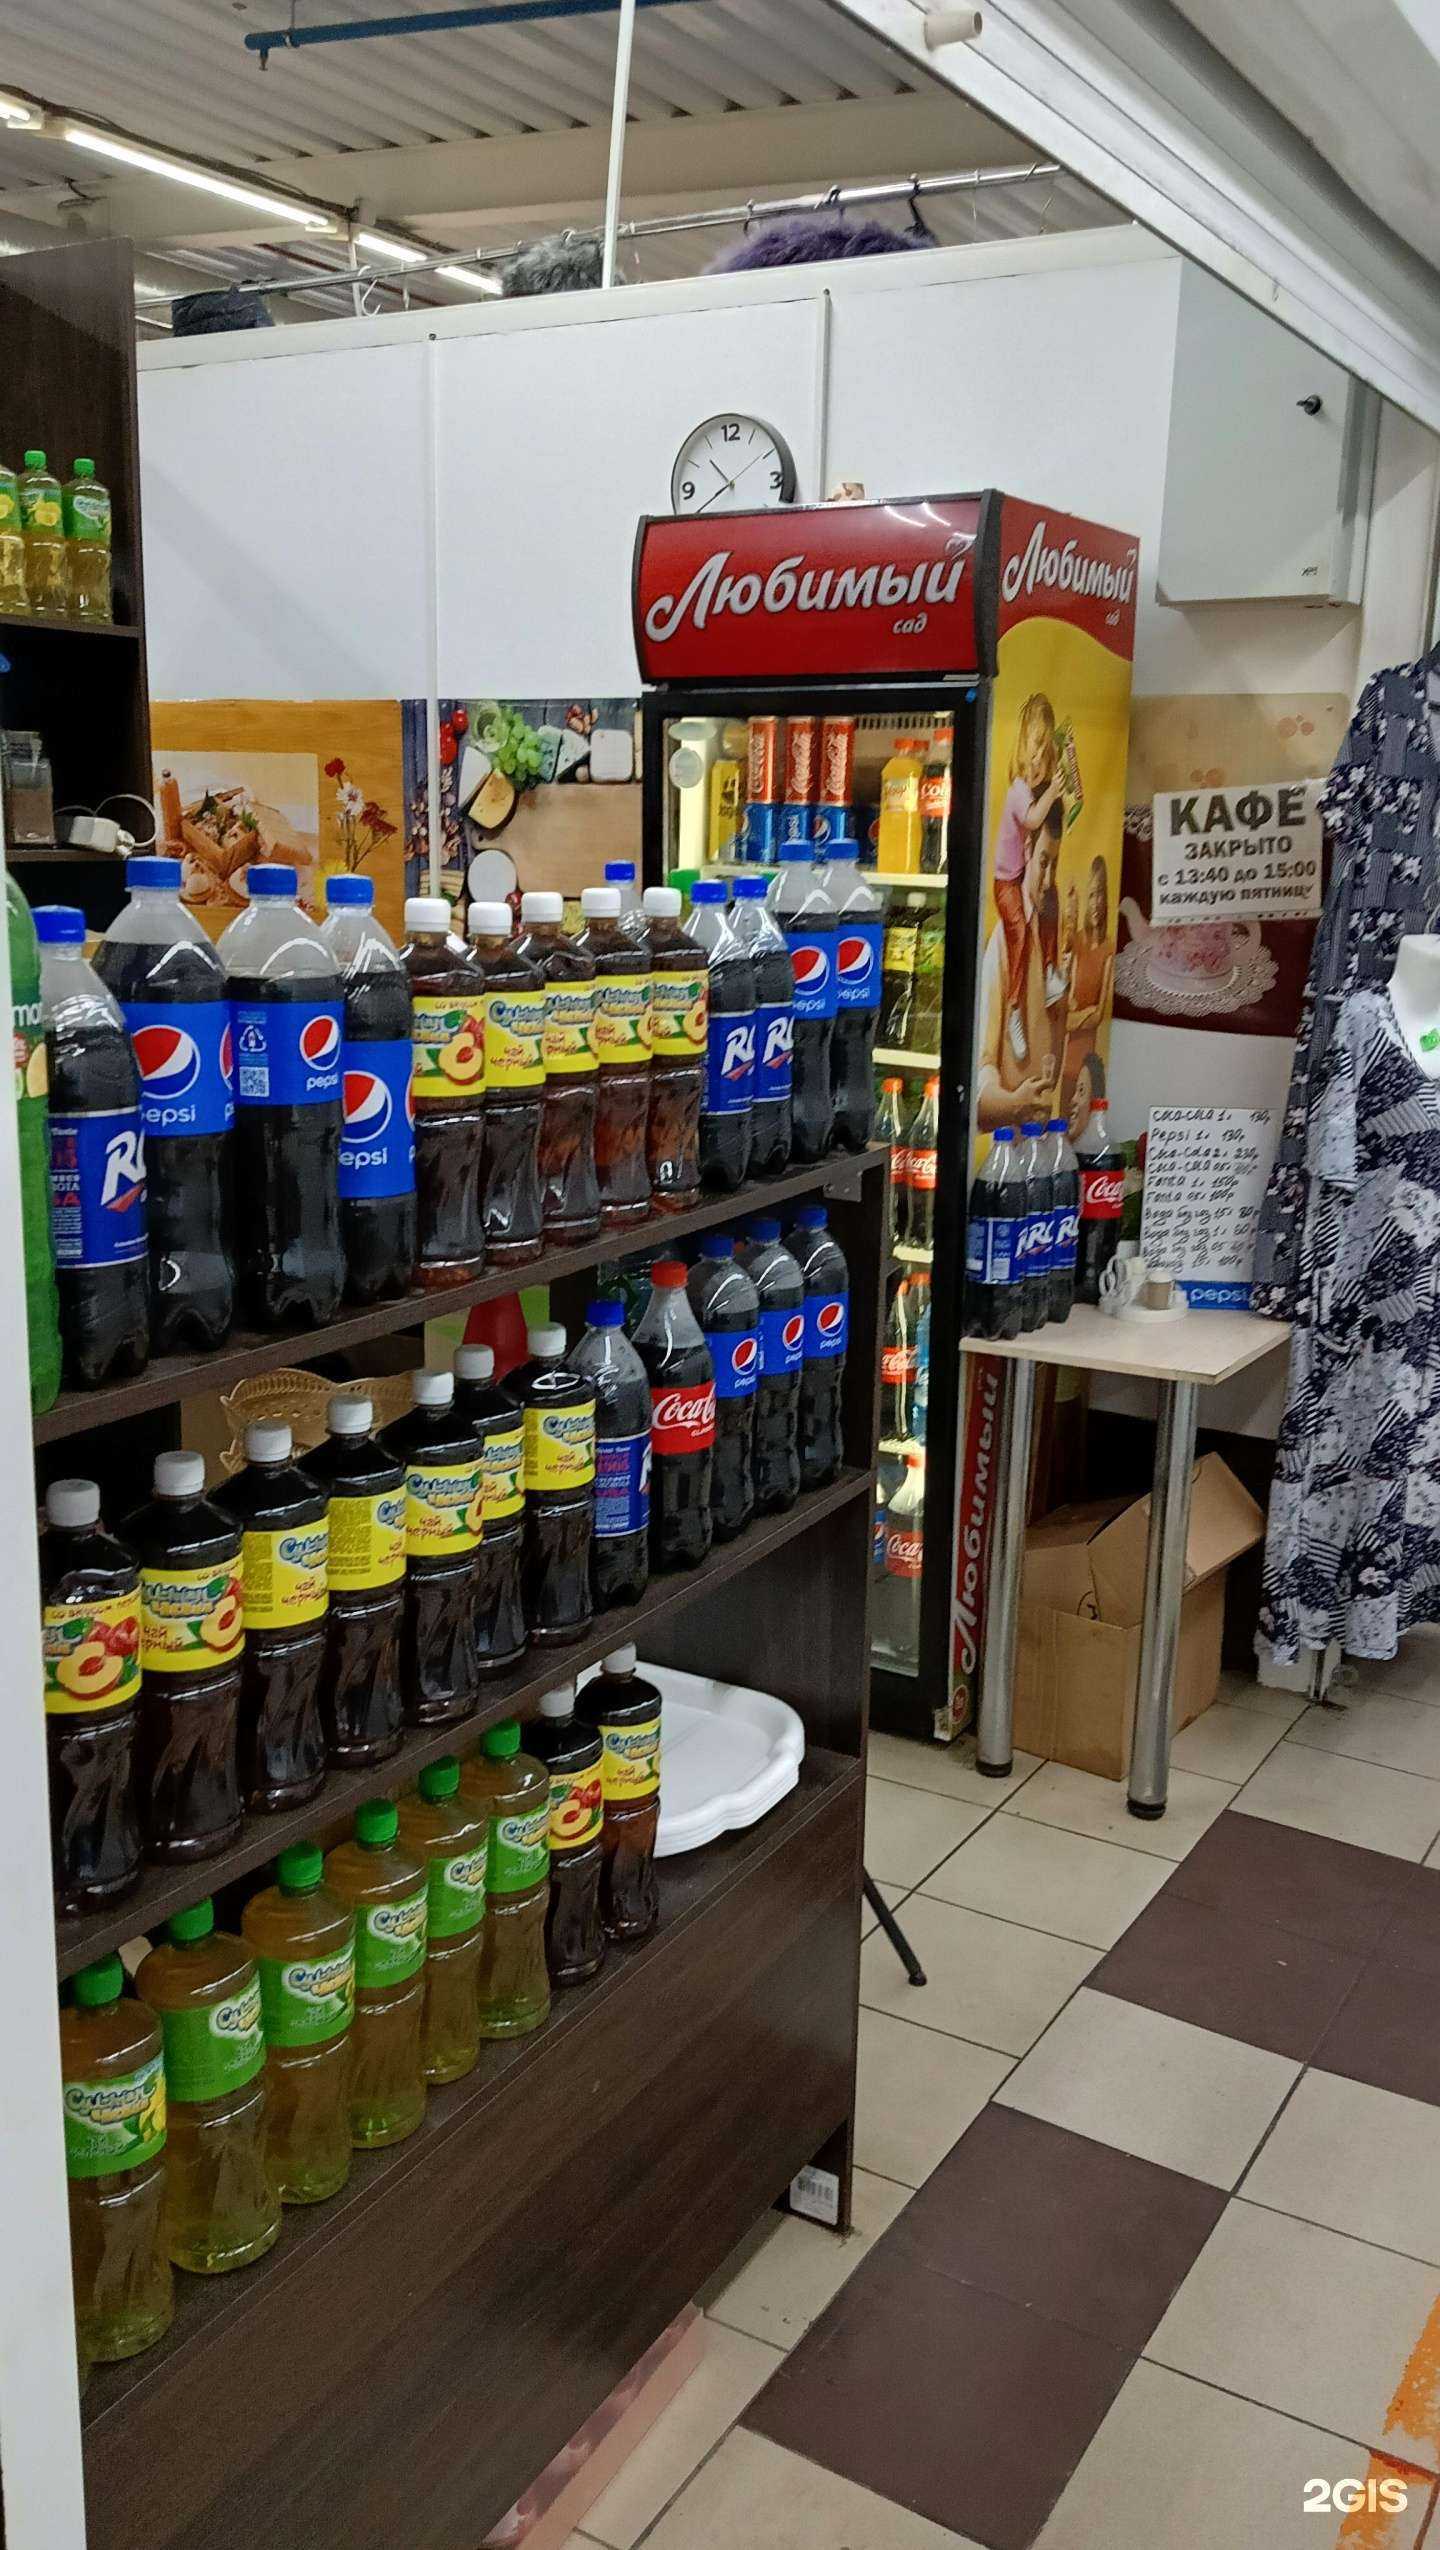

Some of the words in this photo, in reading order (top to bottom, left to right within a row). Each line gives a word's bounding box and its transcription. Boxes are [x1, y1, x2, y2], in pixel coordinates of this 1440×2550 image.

[721, 423, 741, 442] 12
[682, 481, 695, 500] 9
[769, 470, 784, 489] 3
[1002, 521, 1138, 604] Любимый
[645, 531, 978, 643] Любимый
[892, 612, 928, 635] сад
[1169, 786, 1308, 837] КАФЕ
[1184, 836, 1293, 861] ЗАКРЫТО
[1157, 873, 1168, 886] с
[1175, 867, 1229, 886] 13:40
[1233, 868, 1258, 883] до
[1264, 861, 1317, 880] 15:00
[1159, 891, 1235, 906] каждую
[1240, 883, 1314, 901] пятницу
[141, 1105, 196, 1127] epsi
[339, 1147, 388, 1170] epsi
[952, 1366, 998, 1675] Любимый
